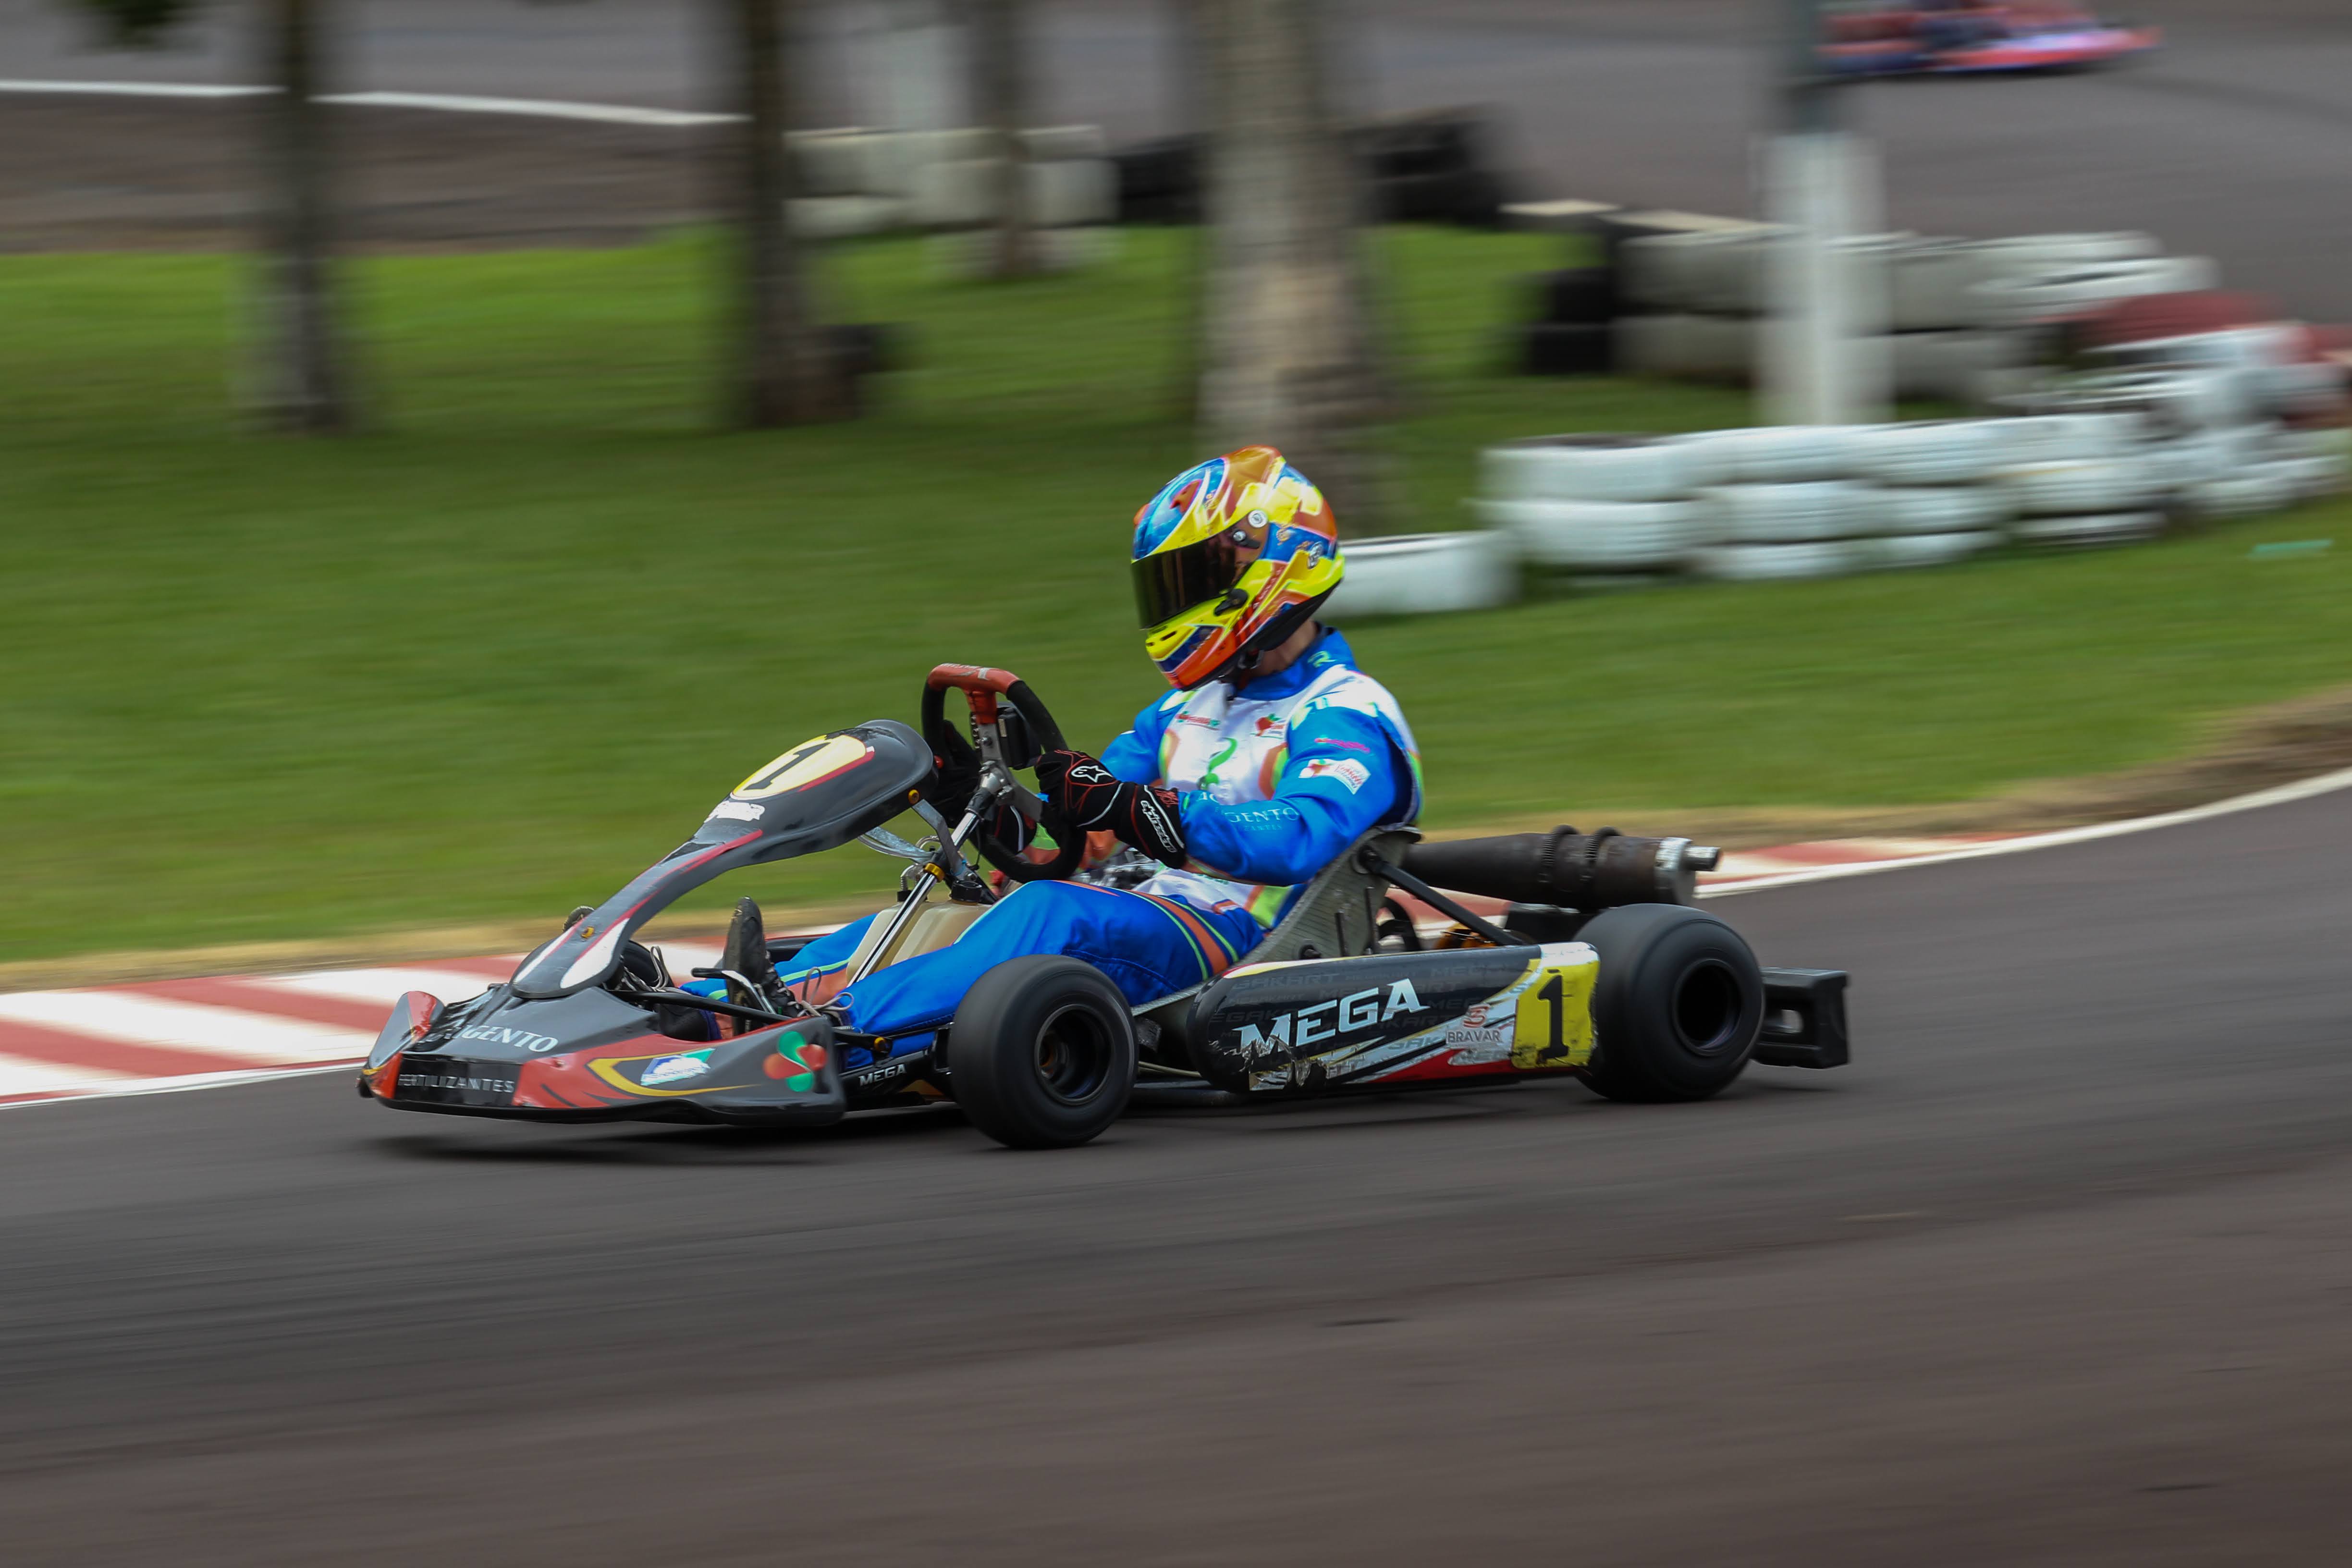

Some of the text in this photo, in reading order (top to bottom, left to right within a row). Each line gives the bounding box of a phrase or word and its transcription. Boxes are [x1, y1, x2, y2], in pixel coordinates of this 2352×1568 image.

[744, 742, 831, 790] 1
[1232, 978, 1430, 1057] MEGA
[1447, 1030, 1502, 1043] BRAVAR
[1539, 975, 1569, 1058] 1
[858, 1064, 907, 1087] MEGA
